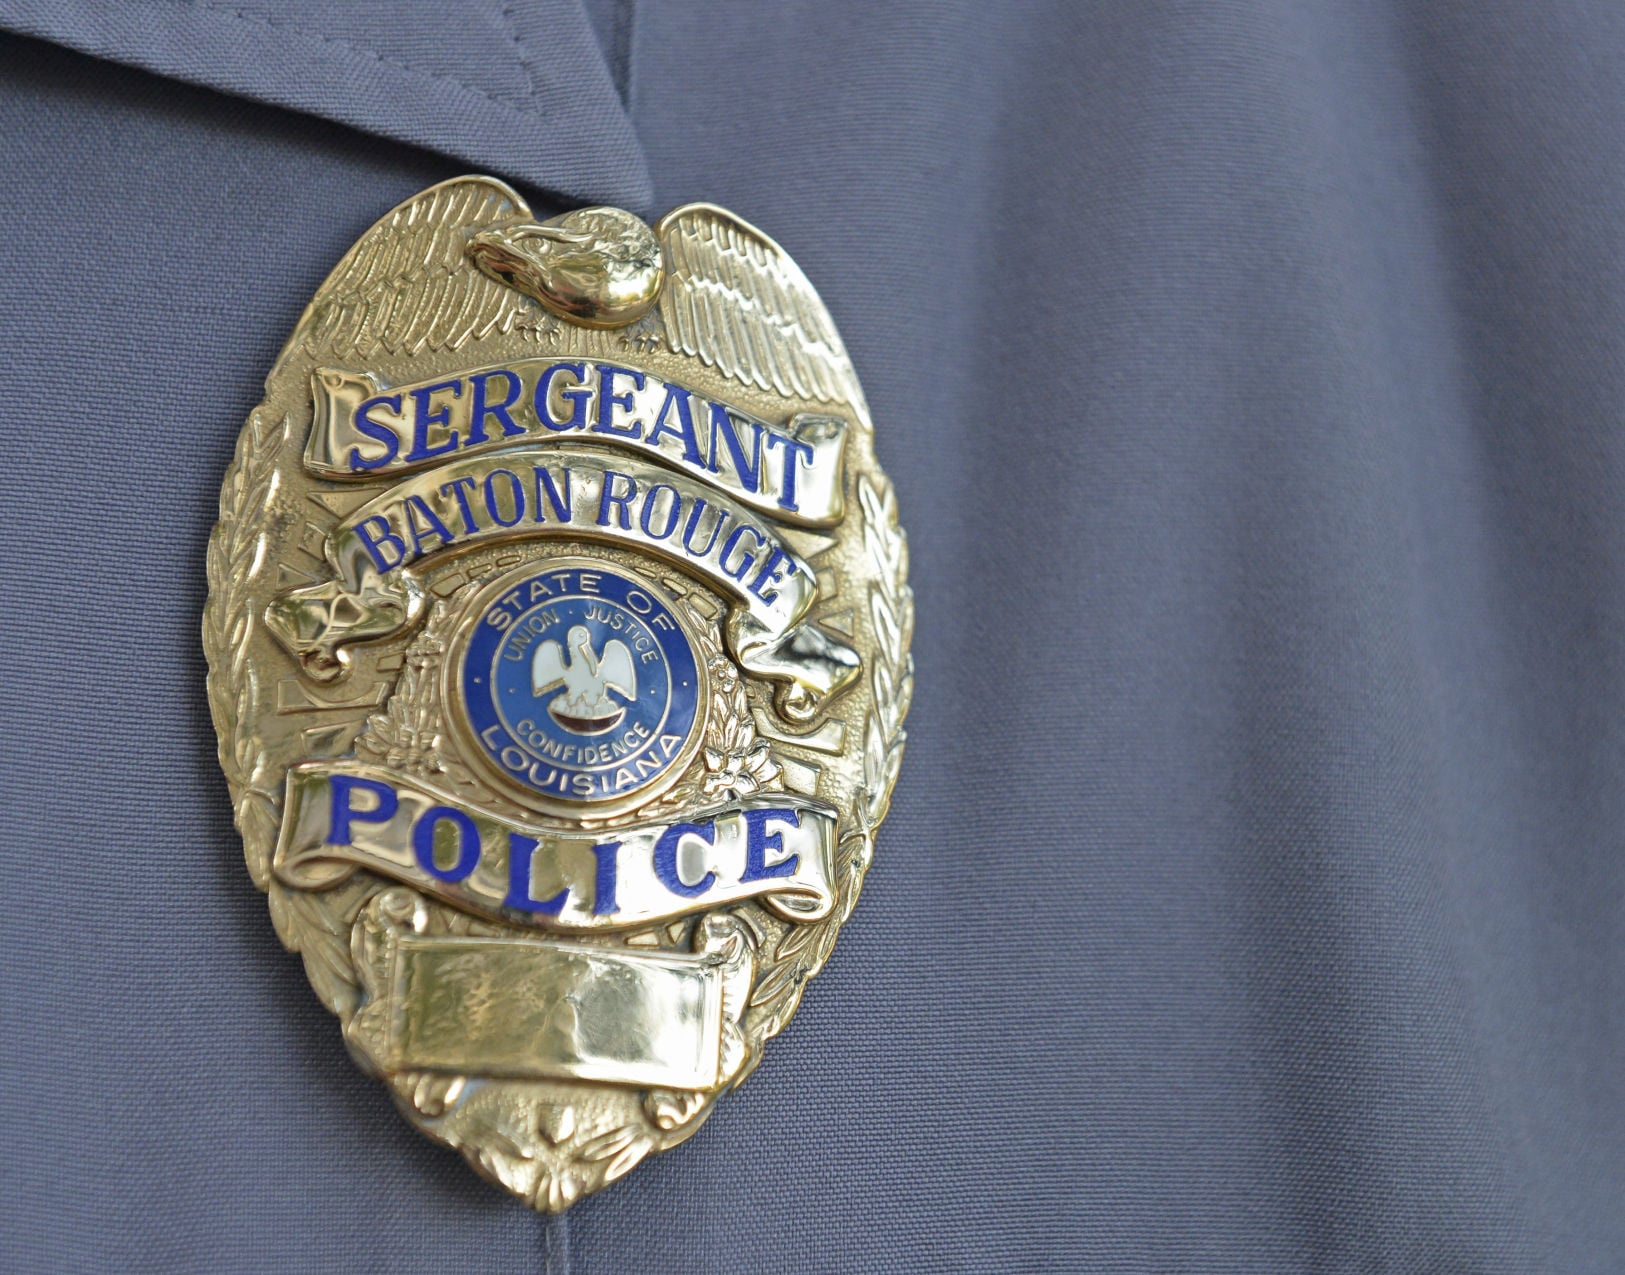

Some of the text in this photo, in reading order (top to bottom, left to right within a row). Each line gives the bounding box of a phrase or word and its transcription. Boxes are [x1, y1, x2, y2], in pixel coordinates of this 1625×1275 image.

[349, 362, 814, 513] SERGEANT
[351, 466, 802, 606] BATON ROUGE
[487, 573, 676, 632] STATE OF
[504, 605, 659, 664] UNION JUSTICE
[481, 724, 682, 795] LOUISIANA
[517, 719, 650, 764] CONFIDENCE
[327, 774, 801, 915] POLICE
